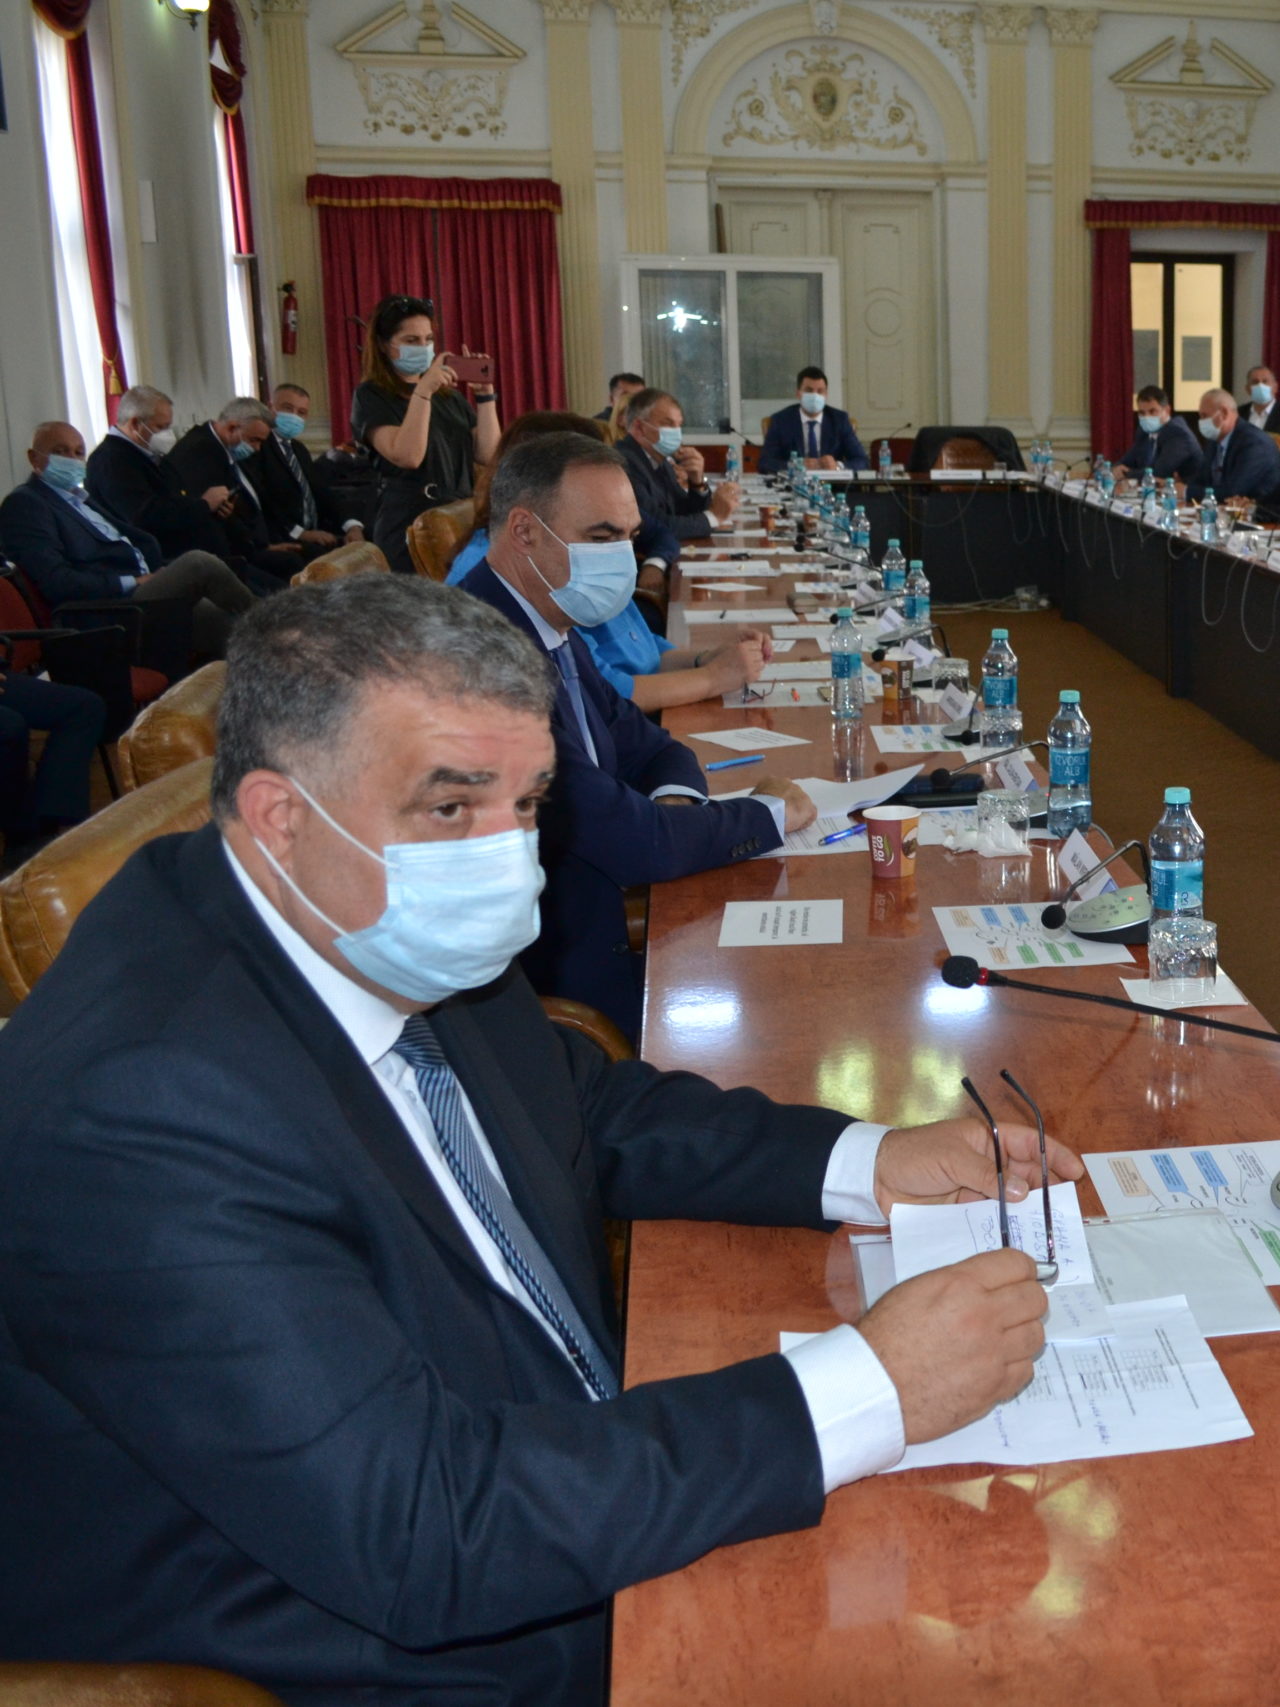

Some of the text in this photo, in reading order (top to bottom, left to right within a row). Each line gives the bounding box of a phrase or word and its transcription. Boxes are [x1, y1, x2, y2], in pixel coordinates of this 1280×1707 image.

[1064, 766, 1080, 776] ALB
[876, 835, 885, 862] TO GO
